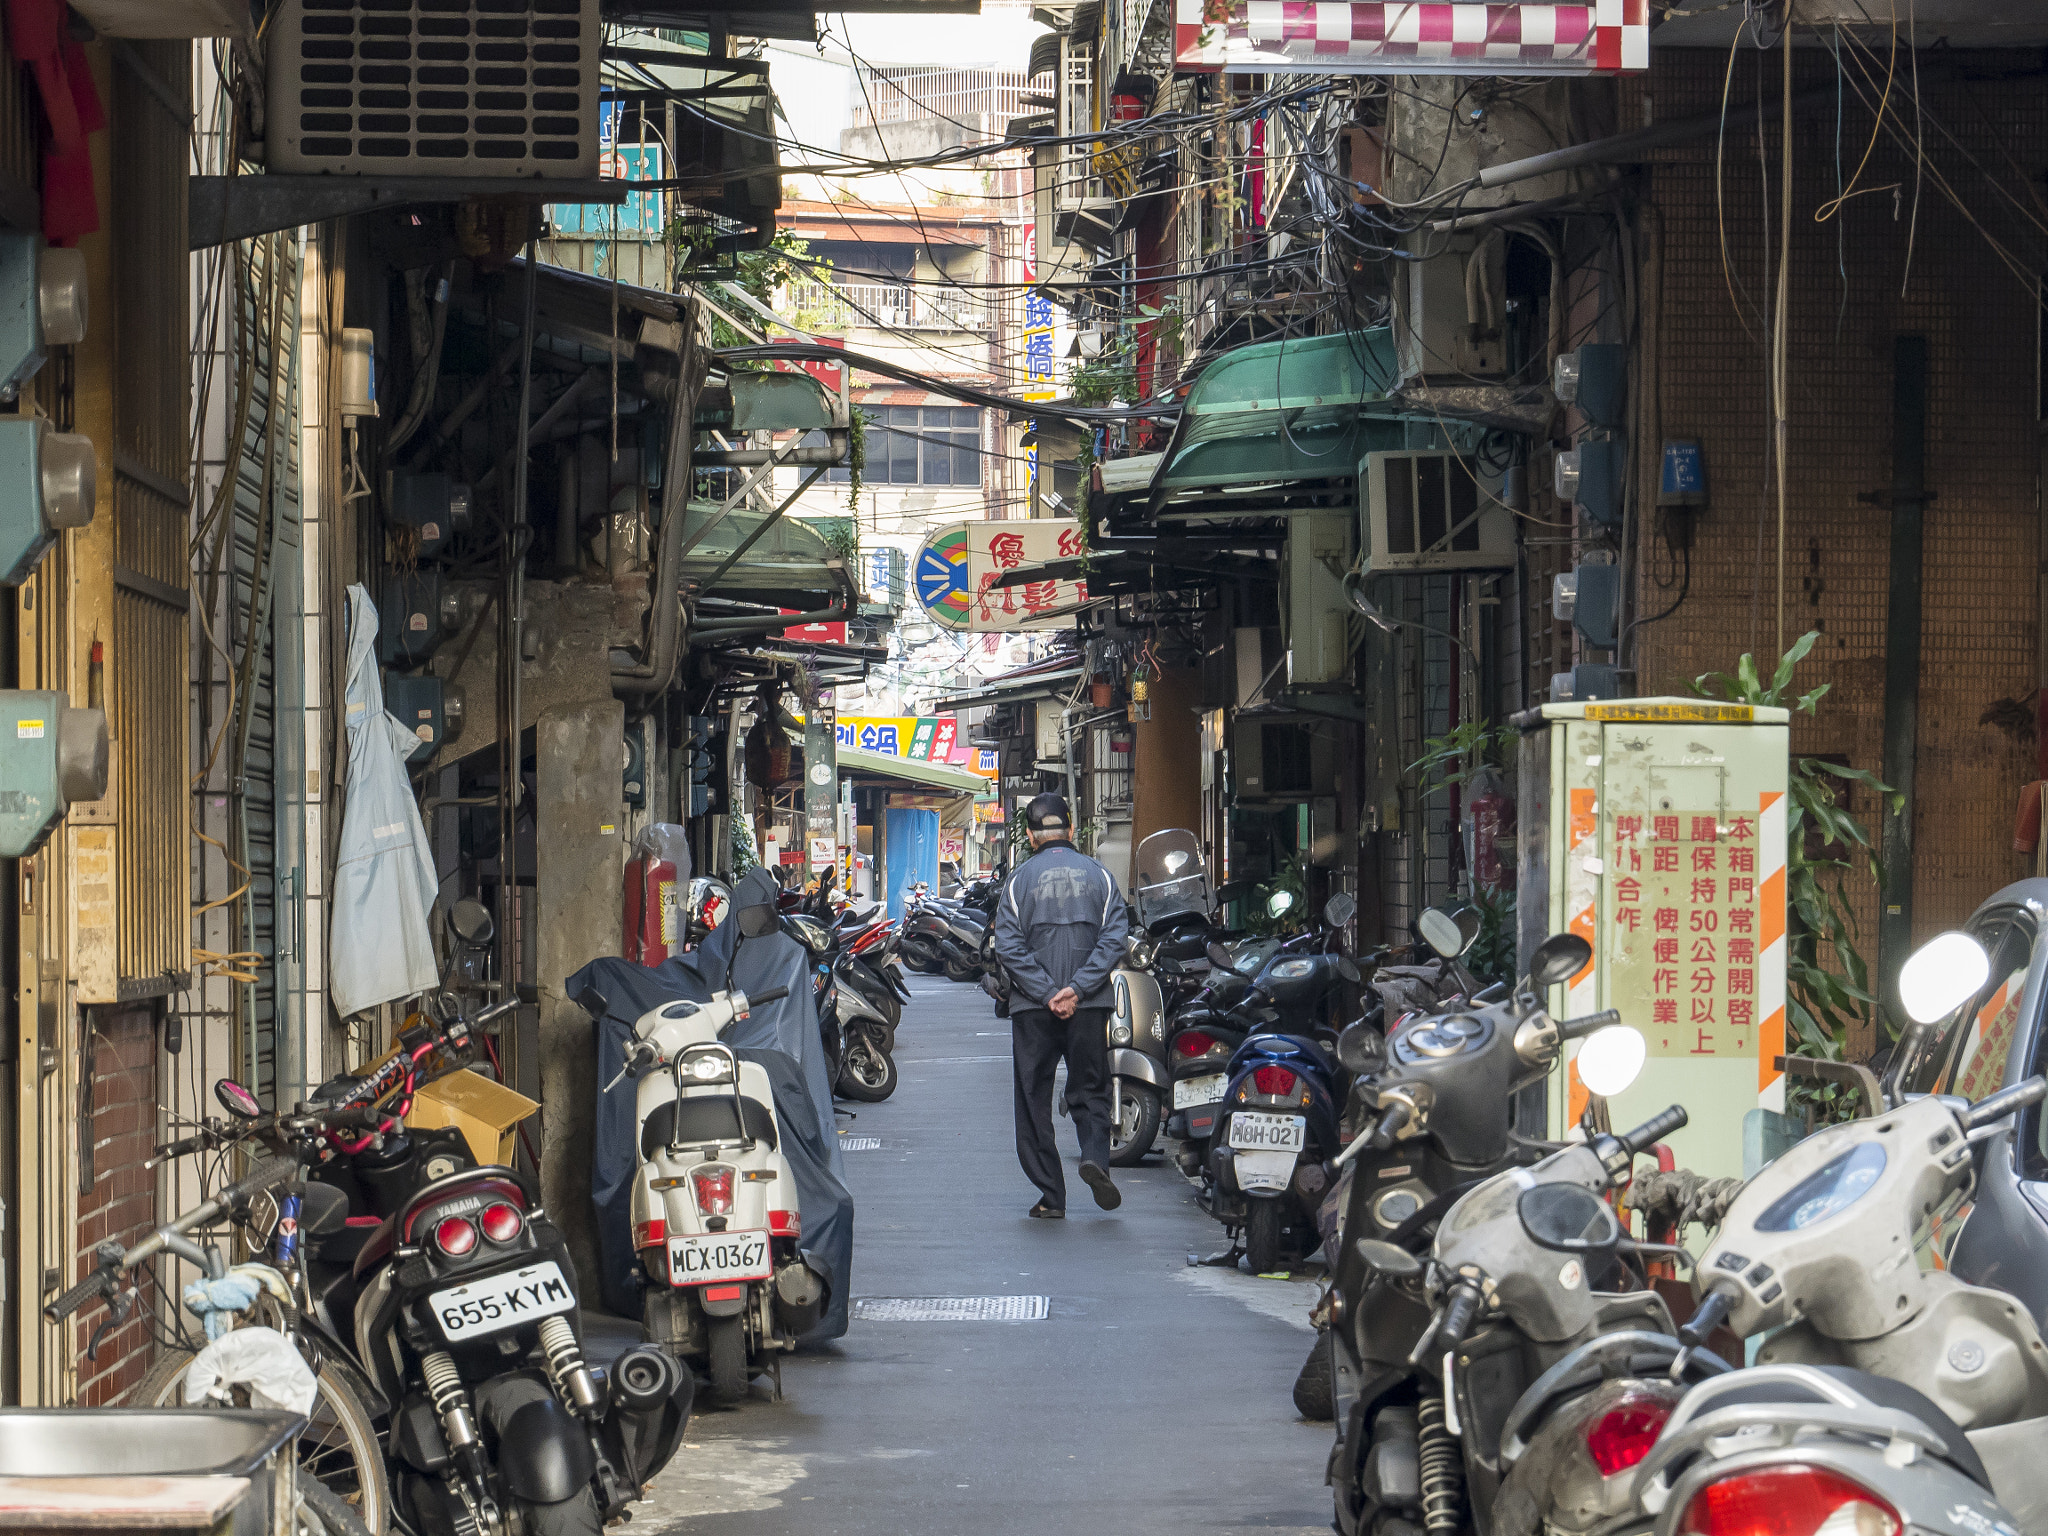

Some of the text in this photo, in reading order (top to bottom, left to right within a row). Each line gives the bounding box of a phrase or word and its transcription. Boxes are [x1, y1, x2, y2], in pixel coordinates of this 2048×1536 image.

[1689, 815, 1719, 1054] 請保持50公分以上
[1231, 1123, 1300, 1146] M8H-021
[437, 1196, 481, 1217] YAMAHA
[672, 1242, 765, 1273] MCX-0367
[441, 1277, 568, 1330] 655-KYM
